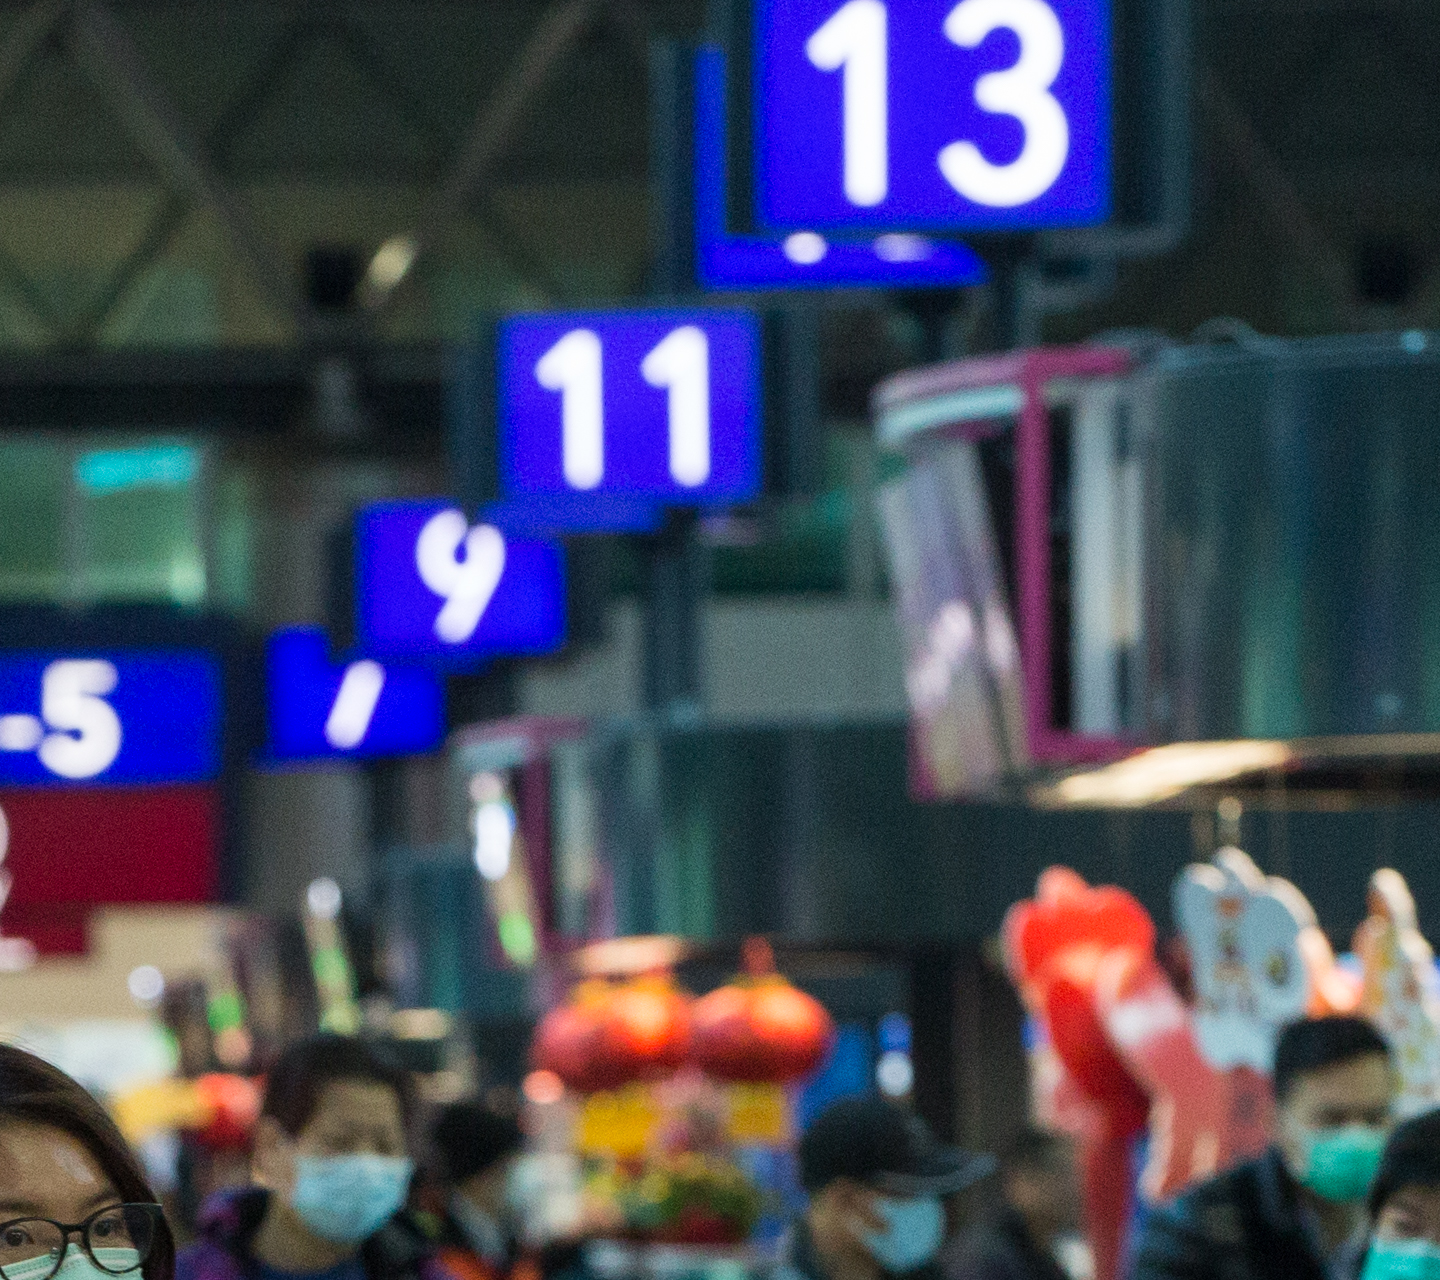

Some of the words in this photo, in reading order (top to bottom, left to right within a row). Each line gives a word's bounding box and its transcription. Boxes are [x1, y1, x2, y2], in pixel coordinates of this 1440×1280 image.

[805, 0, 1071, 208] 13
[534, 325, 712, 492] 11
[414, 508, 507, 645] 9
